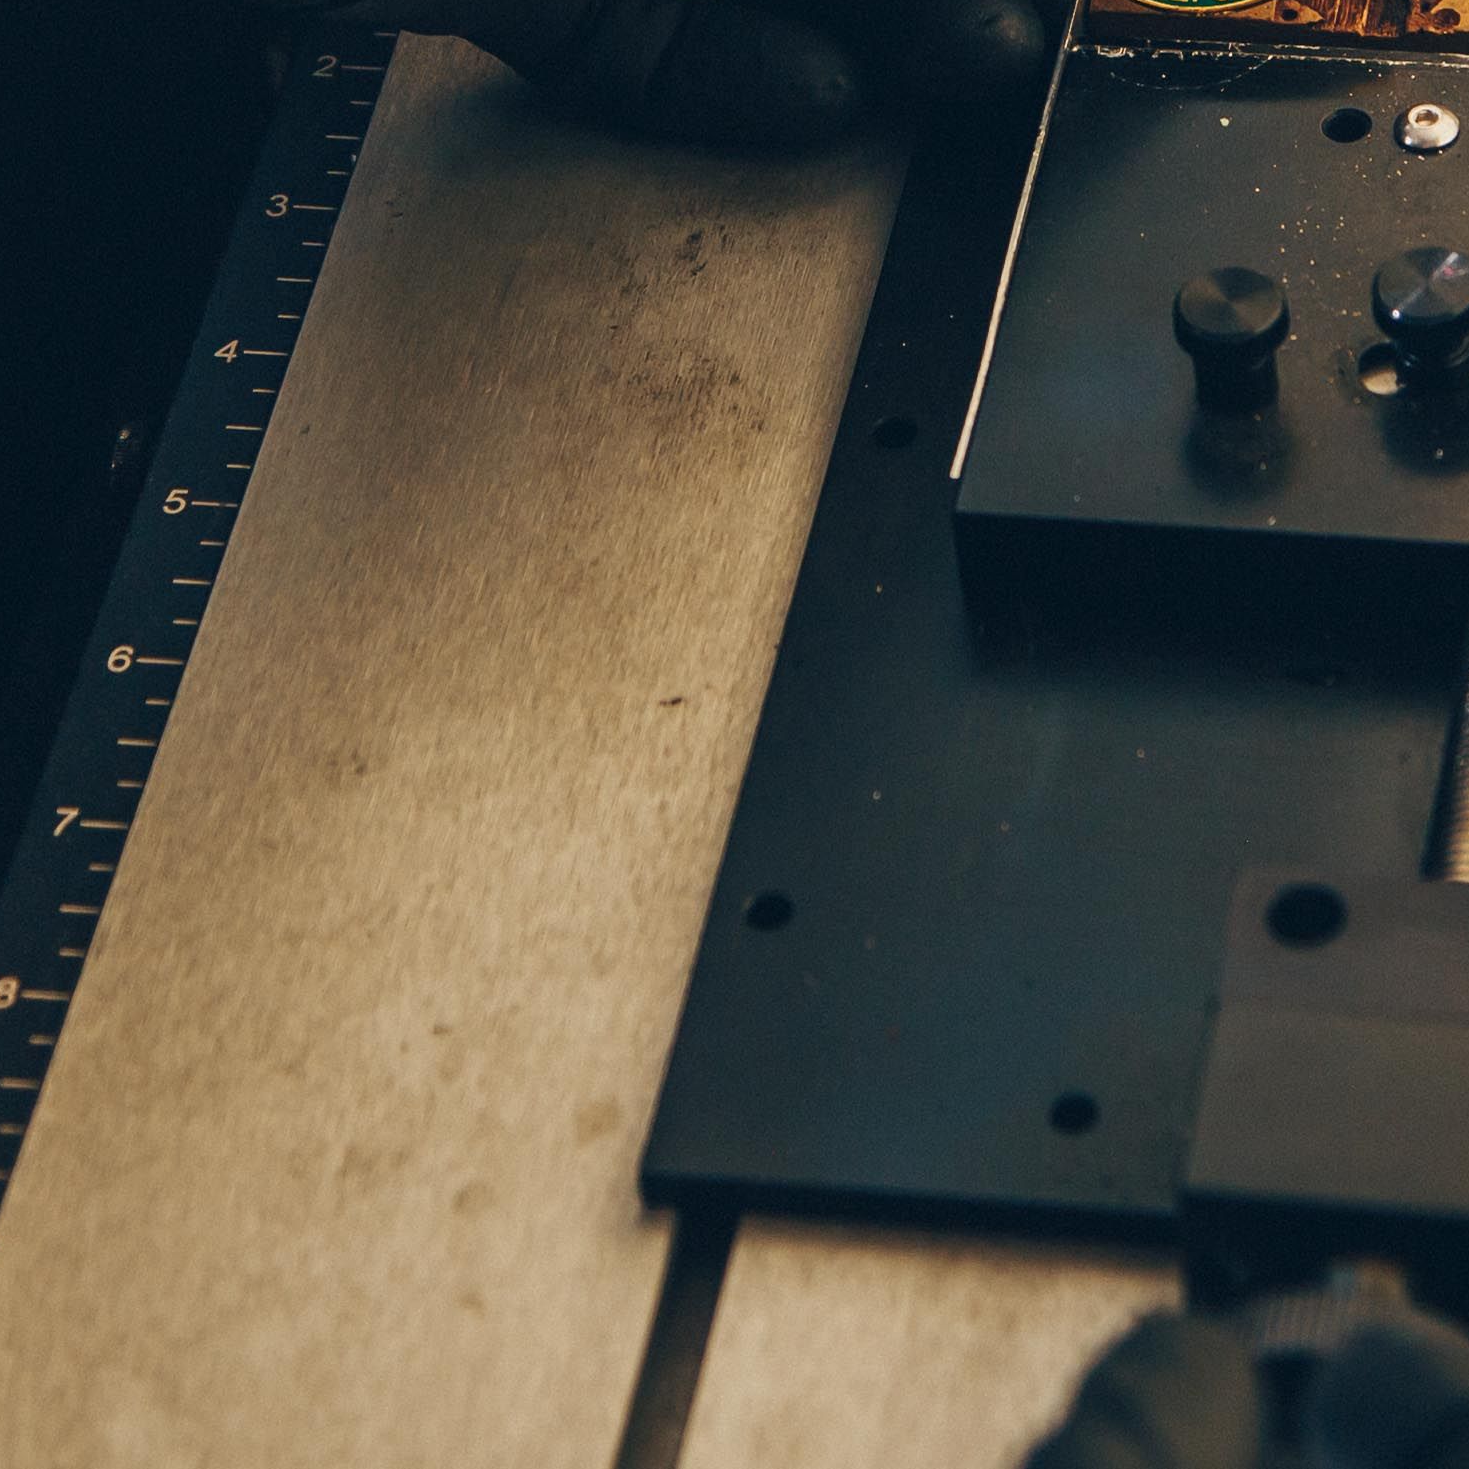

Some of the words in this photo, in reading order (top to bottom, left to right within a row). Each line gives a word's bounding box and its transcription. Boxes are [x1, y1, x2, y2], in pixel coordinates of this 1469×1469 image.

[312, 55, 337, 77] 2
[265, 194, 289, 218] 3
[214, 339, 238, 364] 4
[162, 488, 188, 515] 5
[107, 645, 134, 674] 6
[52, 806, 80, 837] 7
